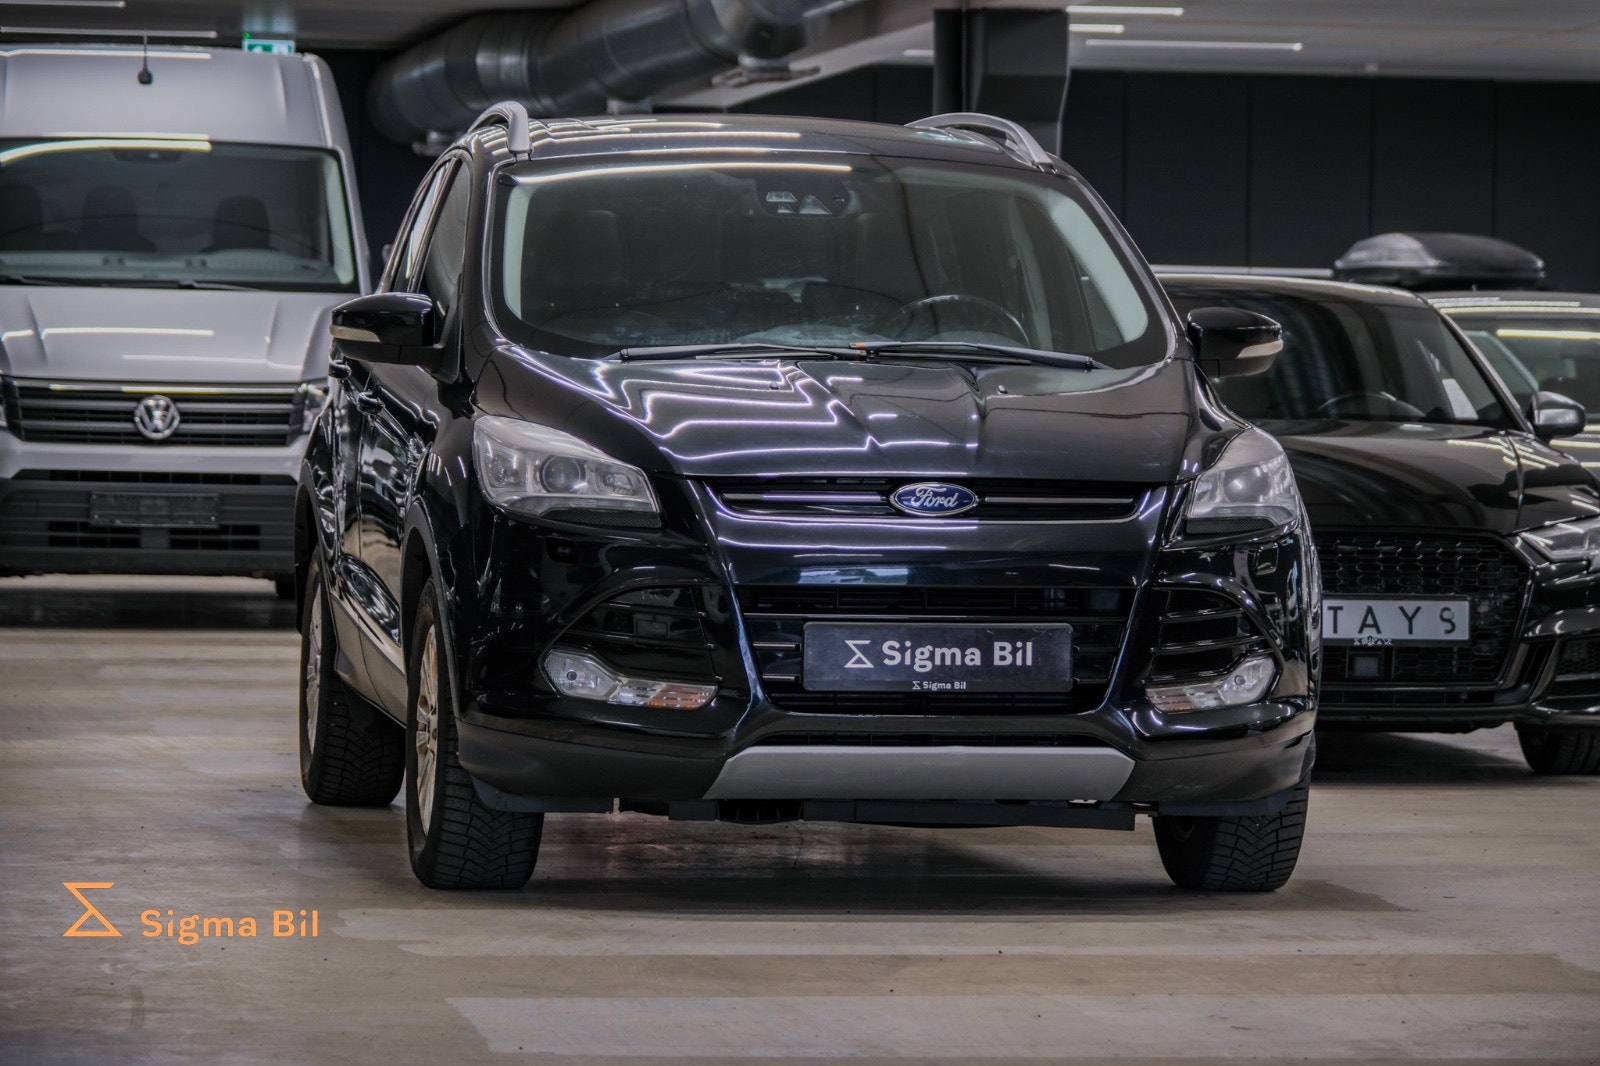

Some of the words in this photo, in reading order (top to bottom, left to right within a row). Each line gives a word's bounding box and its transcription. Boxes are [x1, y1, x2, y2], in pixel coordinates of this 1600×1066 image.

[910, 486, 959, 507] Ford
[882, 640, 981, 672] Sigma
[993, 641, 1033, 666] Bil
[922, 680, 952, 691] Sigma
[953, 681, 967, 690] Bil
